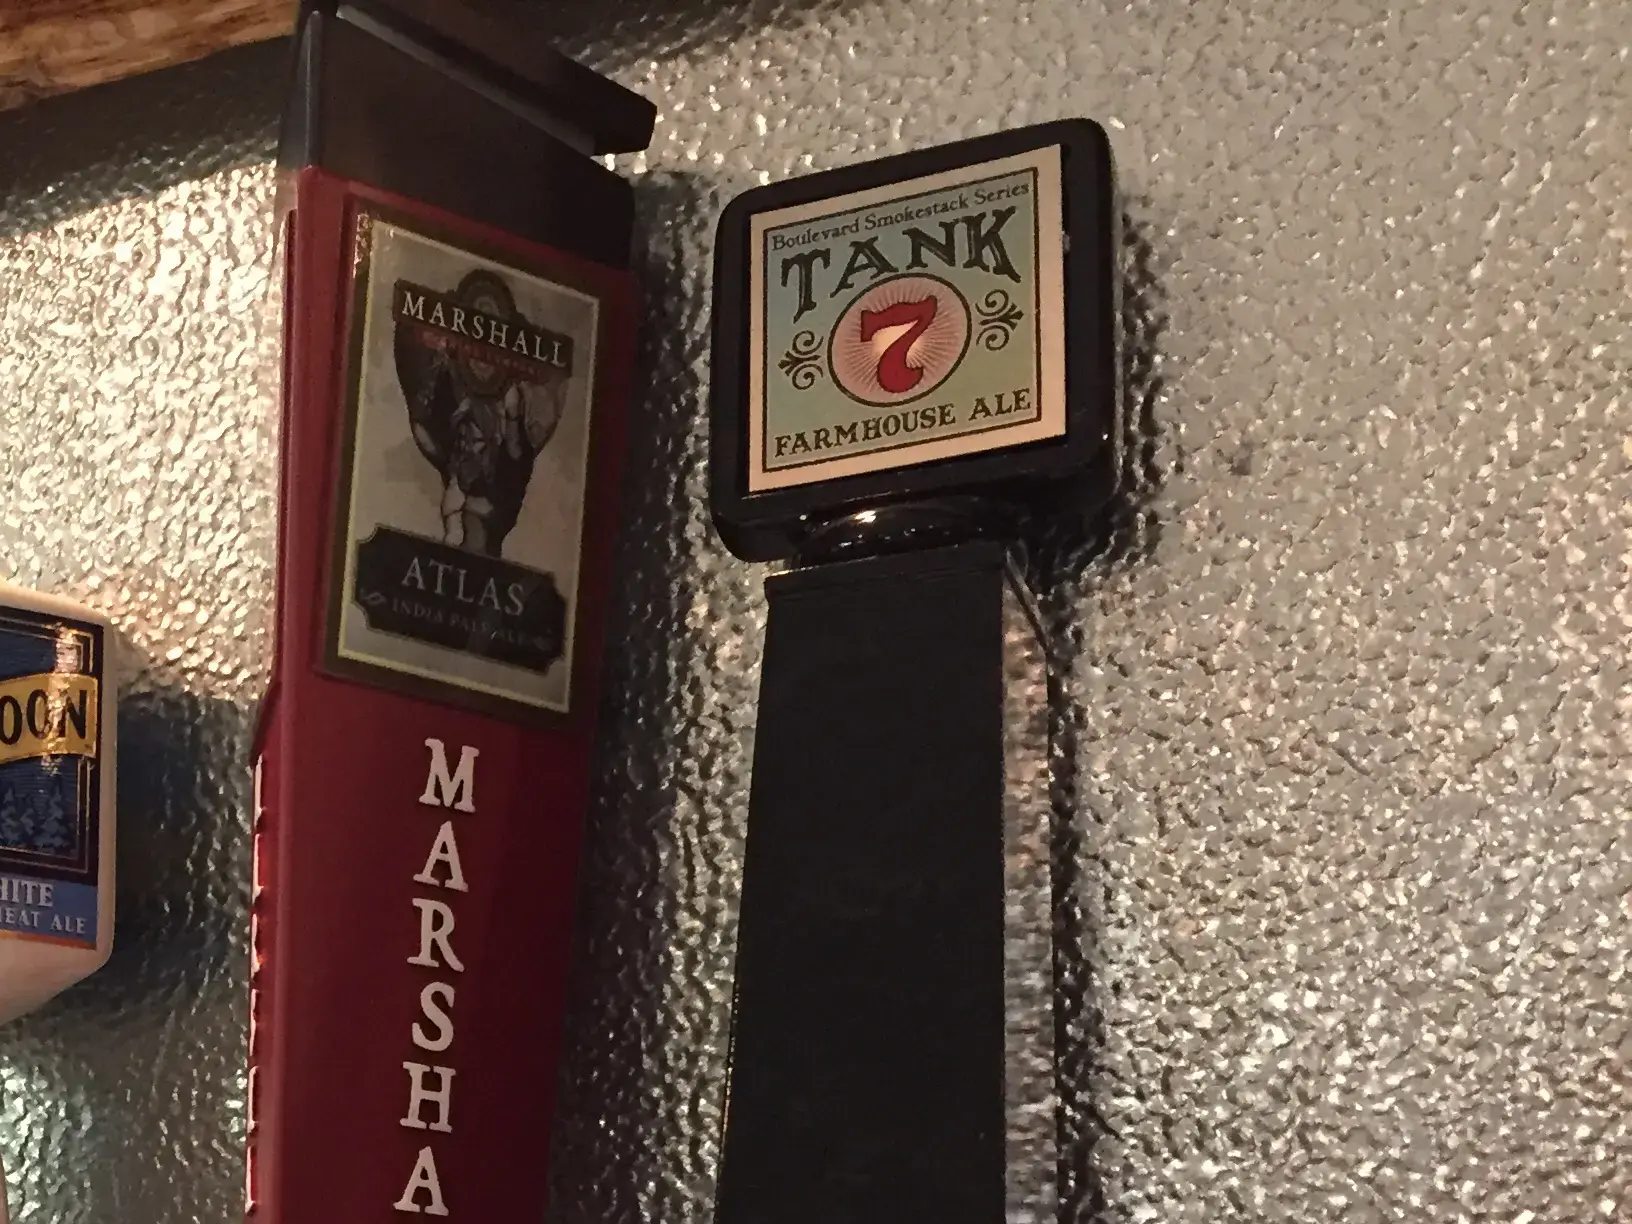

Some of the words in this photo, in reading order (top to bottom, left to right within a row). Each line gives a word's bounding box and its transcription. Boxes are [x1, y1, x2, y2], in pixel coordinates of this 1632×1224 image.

[772, 219, 860, 251] Boulevard
[864, 194, 968, 231] Smokestack
[973, 182, 1030, 205] Series
[780, 205, 1022, 323] TANK
[402, 291, 567, 369] MARSHALL
[860, 295, 937, 393] 7
[774, 404, 956, 458] FARMHOUSE
[969, 387, 1031, 421] ALE
[400, 556, 527, 617] ATLAS
[50, 914, 87, 935] ALE
